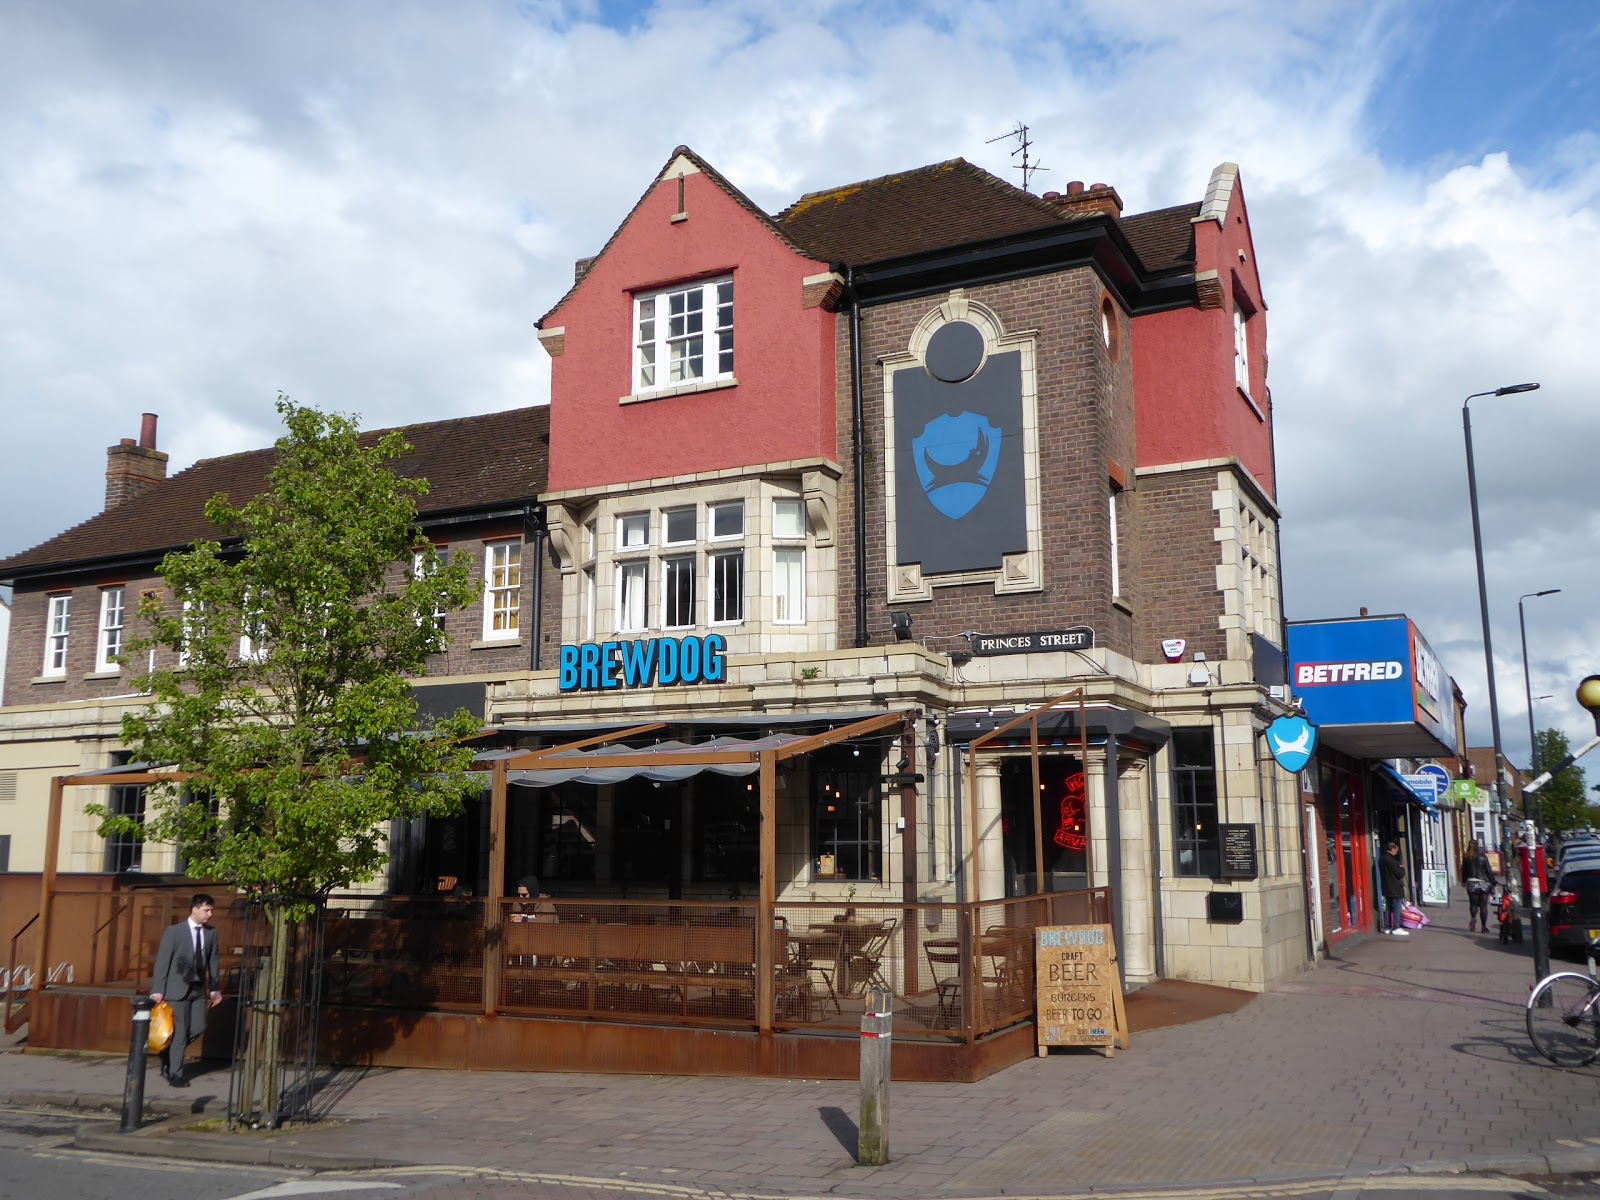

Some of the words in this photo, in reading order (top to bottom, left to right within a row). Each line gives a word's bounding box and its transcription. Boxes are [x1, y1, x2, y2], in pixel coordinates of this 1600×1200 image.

[981, 636, 1031, 650] PRINCES
[1040, 633, 1084, 646] STREET
[559, 634, 726, 691] BREWDOG
[1298, 661, 1403, 684] BETFRED
[1040, 929, 1103, 947] BREWDOG
[1061, 951, 1084, 961] CRAFT
[1049, 962, 1098, 982] BEER
[1050, 992, 1096, 1003] BURGERS
[1046, 1008, 1069, 1021] BEER
[1071, 1008, 1085, 1021] TO
[1086, 1007, 1102, 1021] GO
